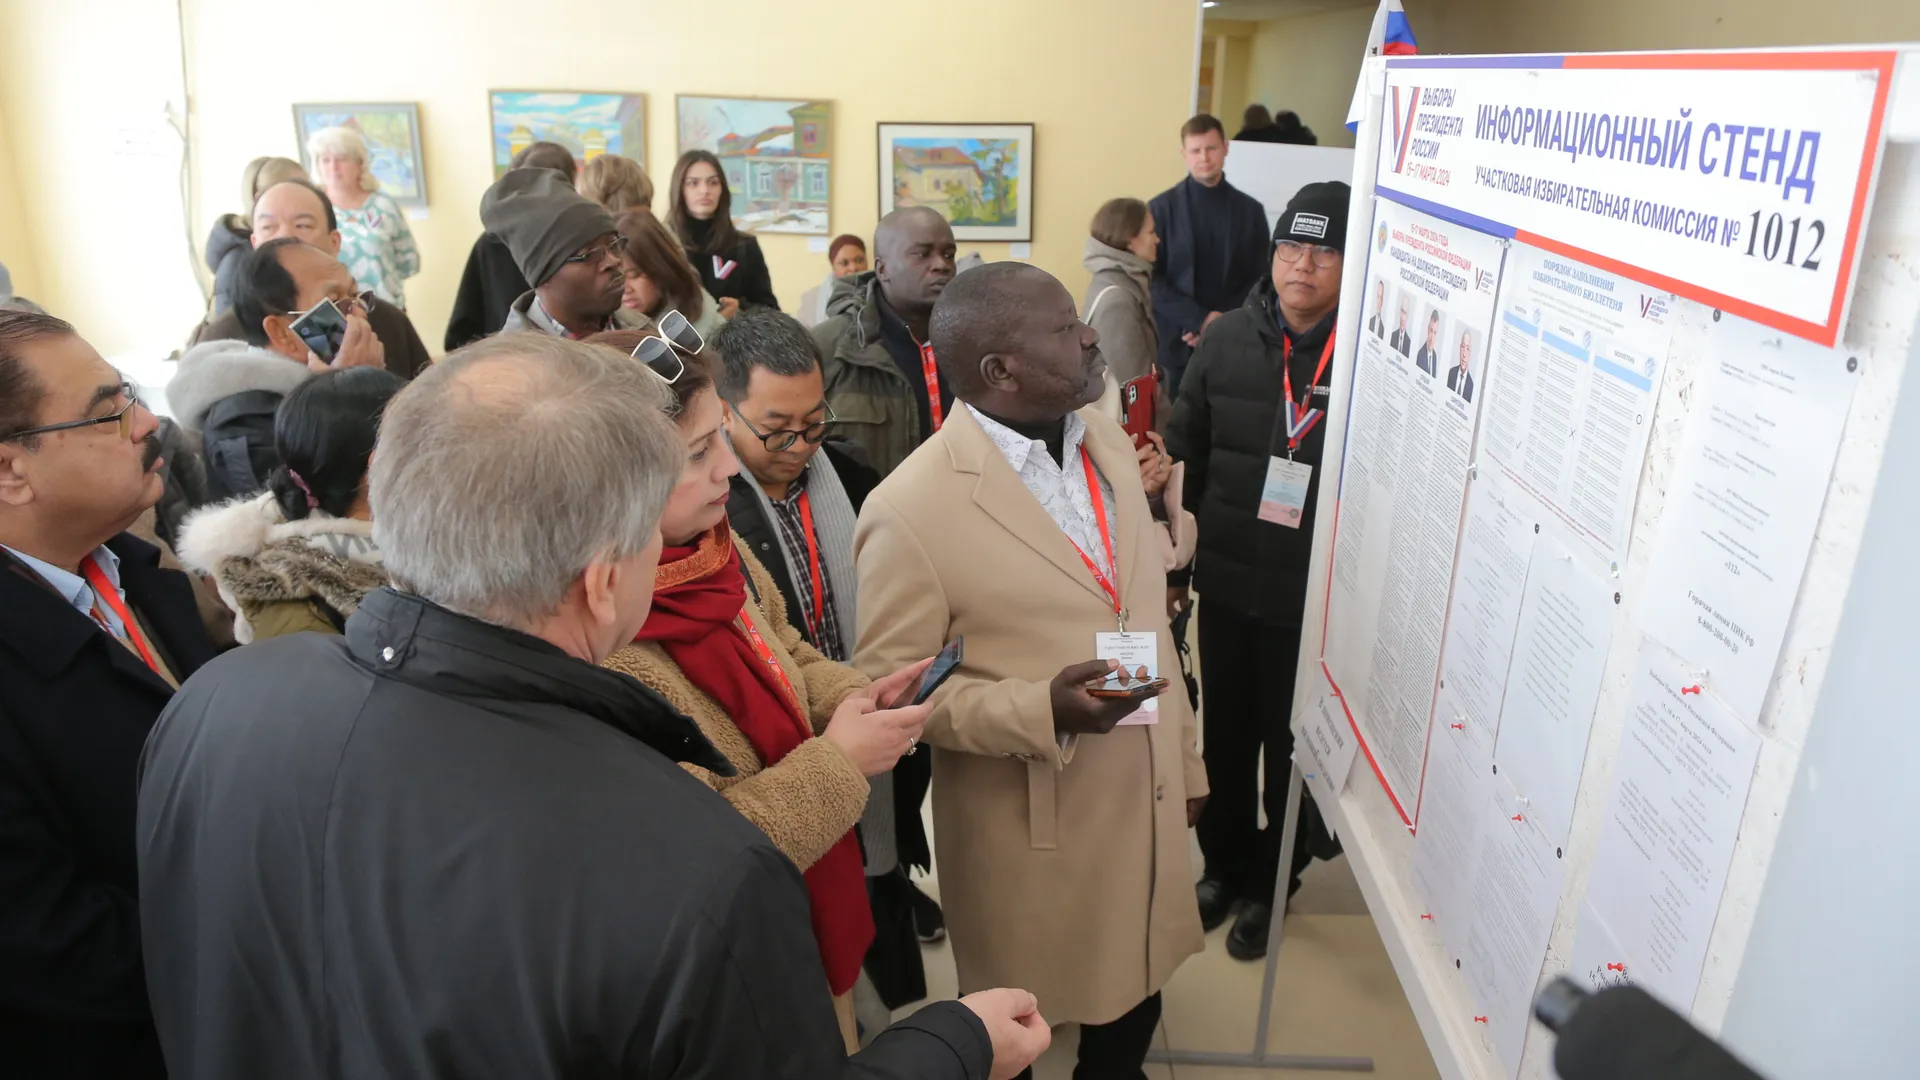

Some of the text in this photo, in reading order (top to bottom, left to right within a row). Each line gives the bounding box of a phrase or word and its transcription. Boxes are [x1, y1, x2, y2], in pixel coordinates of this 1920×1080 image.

[1421, 87, 1457, 108] ВЫБОРЫ
[1416, 113, 1464, 137] ПРЕЗИДЕНТА
[1475, 103, 1693, 171] ИНФОРМАЦИОННЫЙ
[1410, 138, 1440, 160] РОССИИ
[1698, 122, 1821, 205] СТЕНД
[1419, 163, 1438, 183] МАРТА
[1475, 165, 1826, 271] УЧАСТКОВАЯ ИЗБИРАТЕЛЬНАЯ КОМИССИЯ № 1012
[1532, 270, 1623, 312] ИЗБИРАТЕЛЬНОГО БЮЛЛЕТЕНЯ
[1543, 259, 1615, 293] ПОРЯДОК ЗАПОЛНЕНИЯ
[1730, 621, 1746, 641] ЦИК
[1744, 632, 1755, 647] РФ
